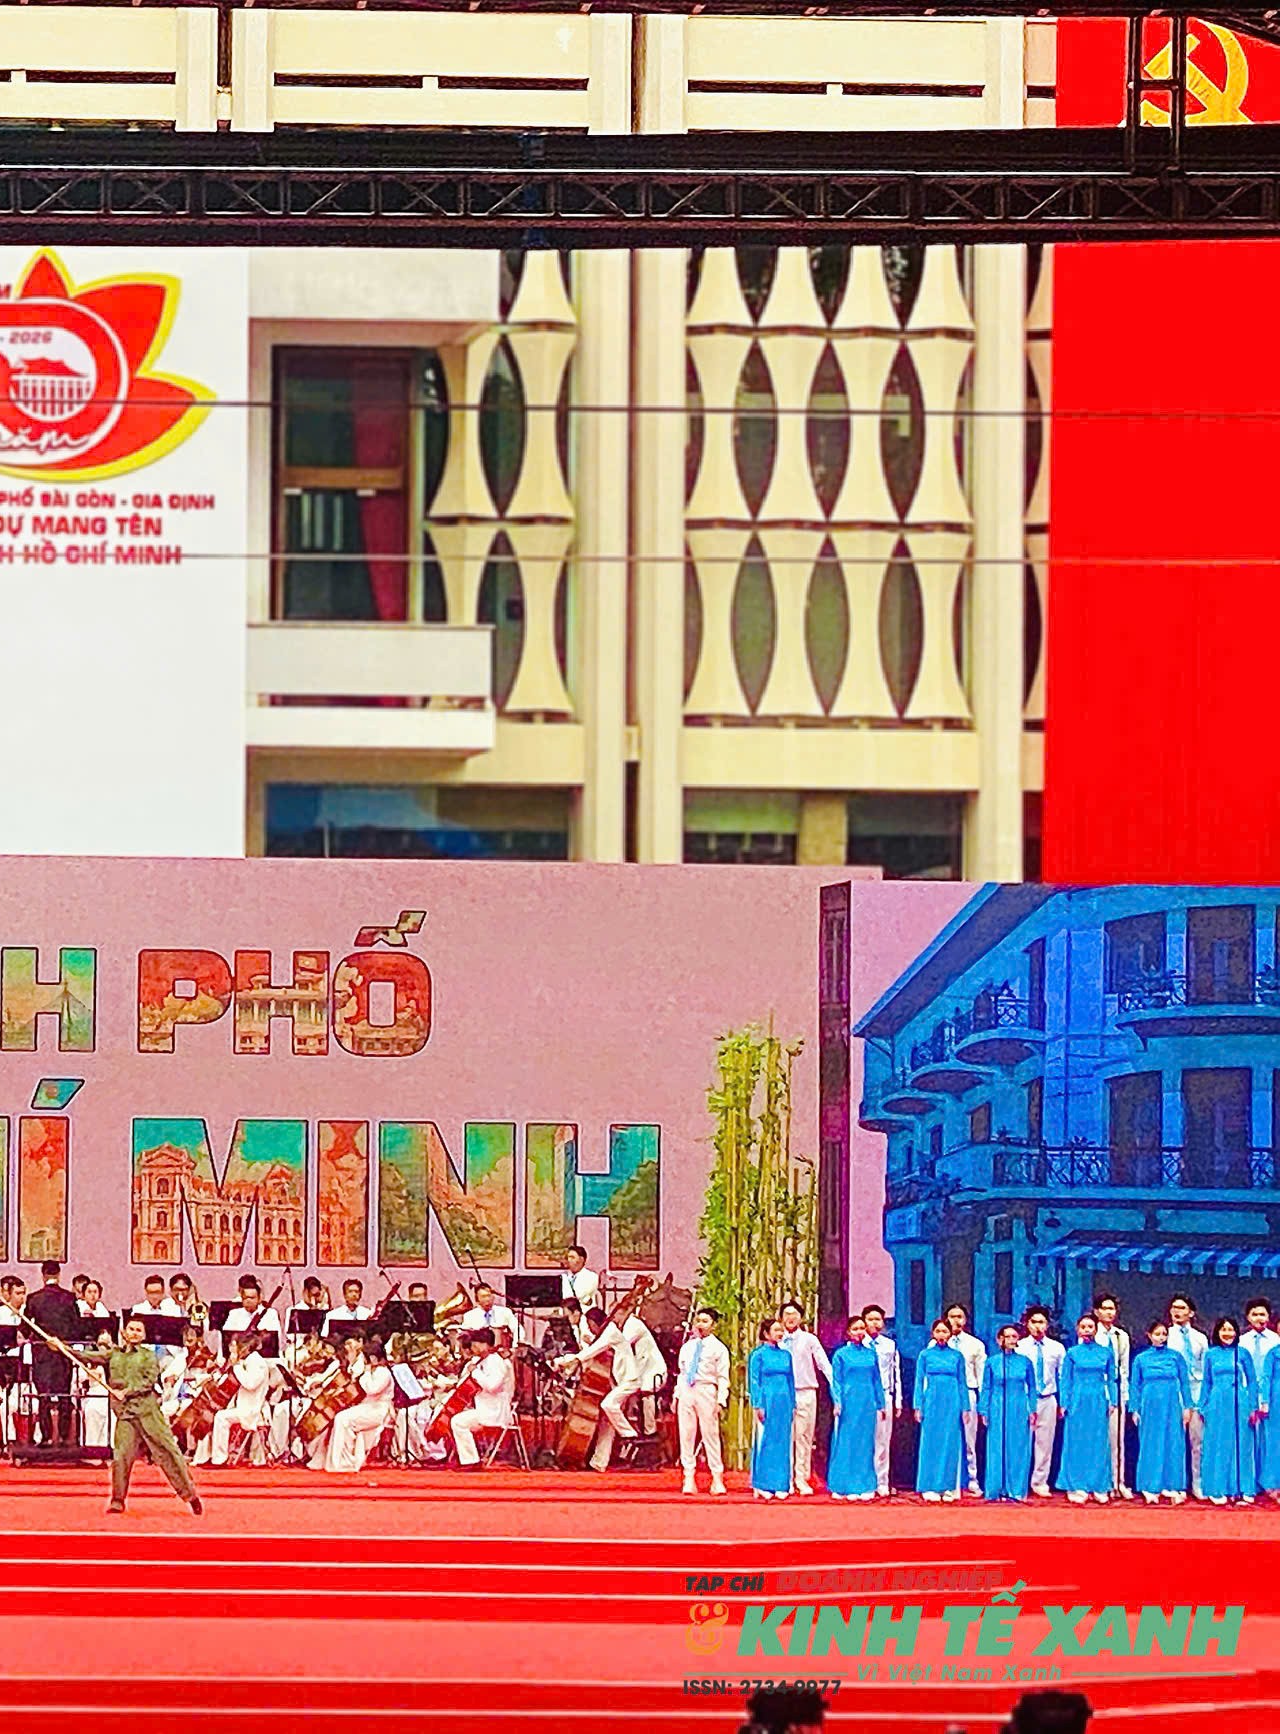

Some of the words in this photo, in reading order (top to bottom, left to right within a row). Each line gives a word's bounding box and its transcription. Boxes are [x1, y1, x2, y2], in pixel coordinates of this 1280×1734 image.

[9, 331, 53, 345] 2026
[76, 489, 115, 509] GÒN
[132, 493, 162, 509] GIA
[32, 515, 107, 536] MANG
[115, 512, 163, 537] TÊN
[23, 537, 56, 565] HỒ
[65, 540, 108, 566] CHÍ
[115, 544, 182, 567] MINH
[137, 909, 433, 1058] PHỐ
[131, 1117, 662, 1271] MINH
